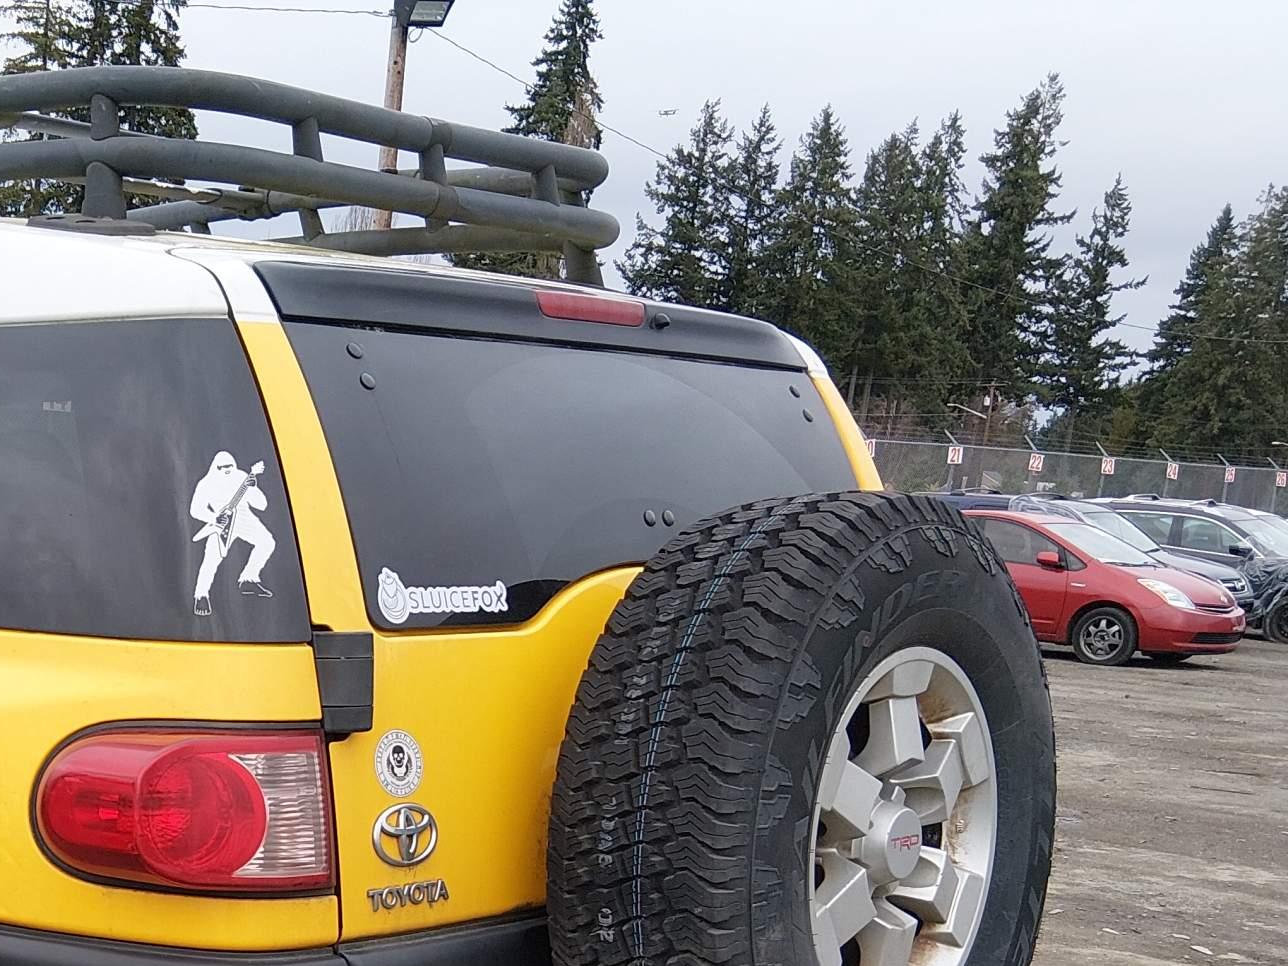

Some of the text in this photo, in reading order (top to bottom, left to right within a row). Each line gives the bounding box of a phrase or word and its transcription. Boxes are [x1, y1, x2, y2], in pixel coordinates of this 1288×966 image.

[949, 448, 961, 463] 21
[1030, 455, 1043, 469] 22
[1102, 458, 1113, 473] 23
[1167, 463, 1178, 478] 24
[1226, 468, 1235, 481] 25
[1276, 472, 1287, 485] 26
[408, 588, 506, 609] SLUICEFOX
[890, 834, 920, 853] TRD
[367, 879, 449, 912] TOYOTA
